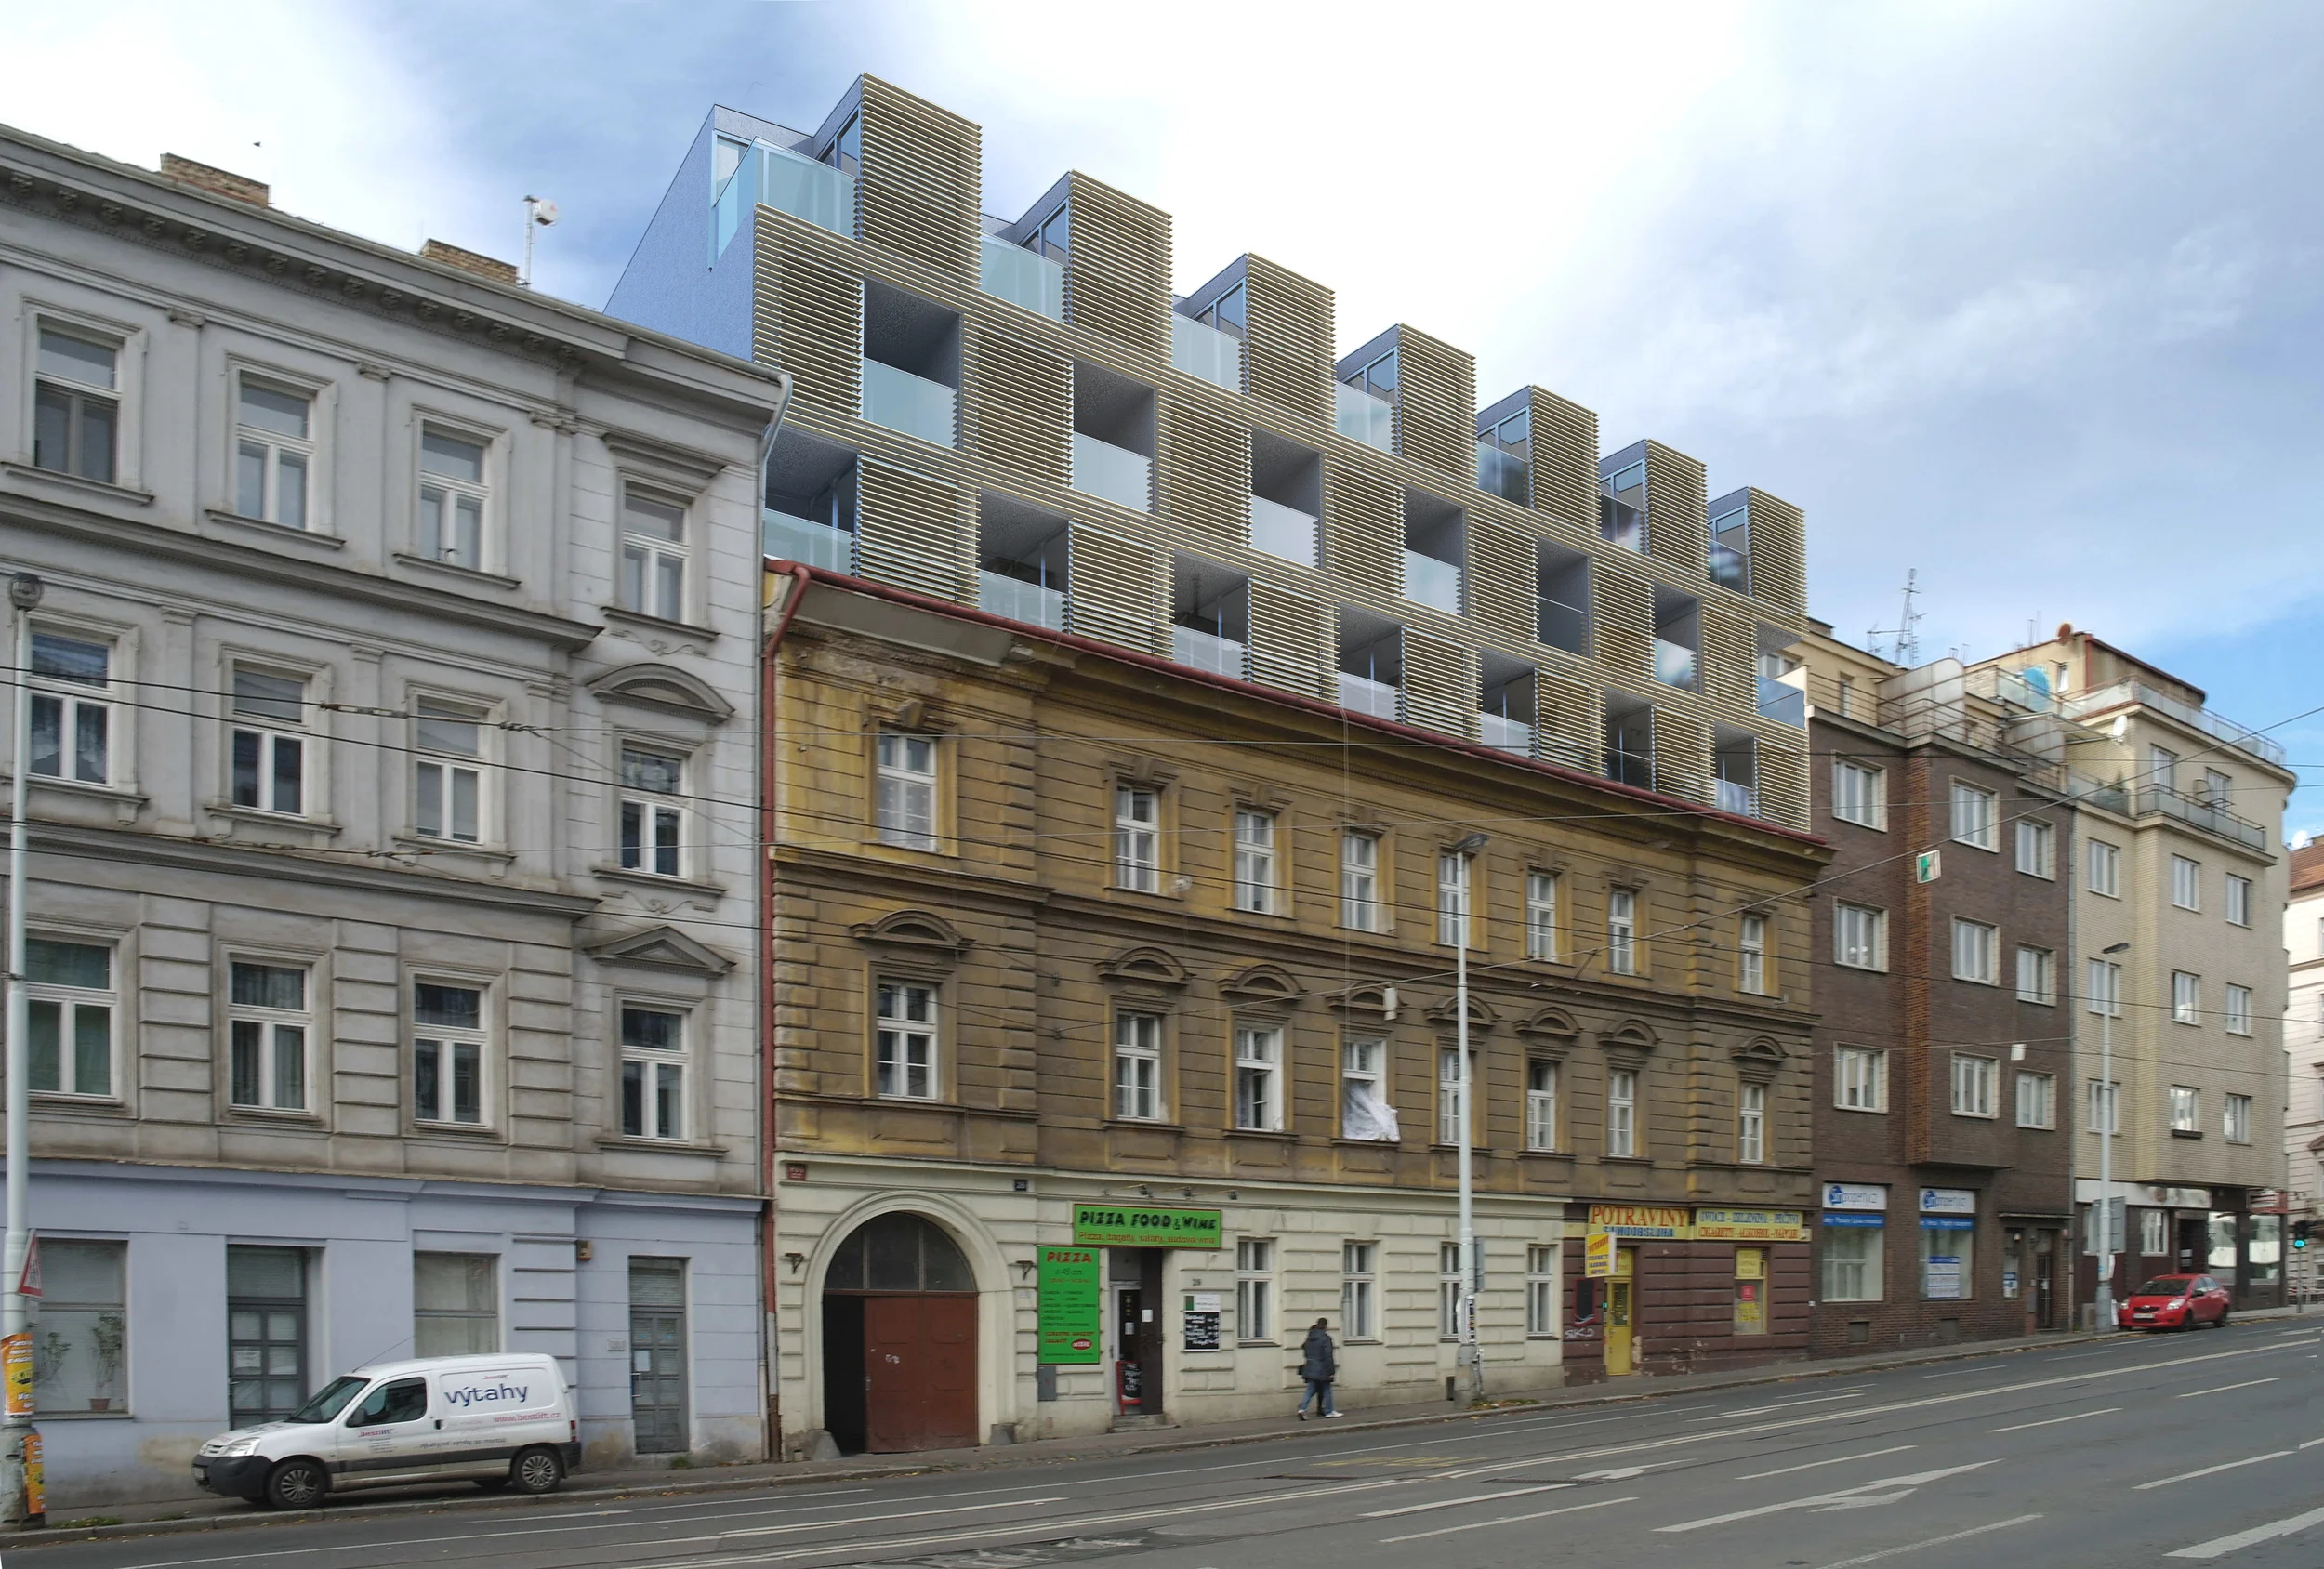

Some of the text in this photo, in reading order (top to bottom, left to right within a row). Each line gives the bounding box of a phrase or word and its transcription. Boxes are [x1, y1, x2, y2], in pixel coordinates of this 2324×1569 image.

[1079, 1211, 1125, 1225] PIZZA
[1130, 1213, 1171, 1228] FOOD
[1182, 1216, 1217, 1230] WINE
[1591, 1205, 1688, 1227] POTRAVINY
[1046, 1251, 1093, 1264] PIZZA
[444, 1383, 528, 1407] výtahy
[493, 1413, 561, 1423] www.bestlift.cz
